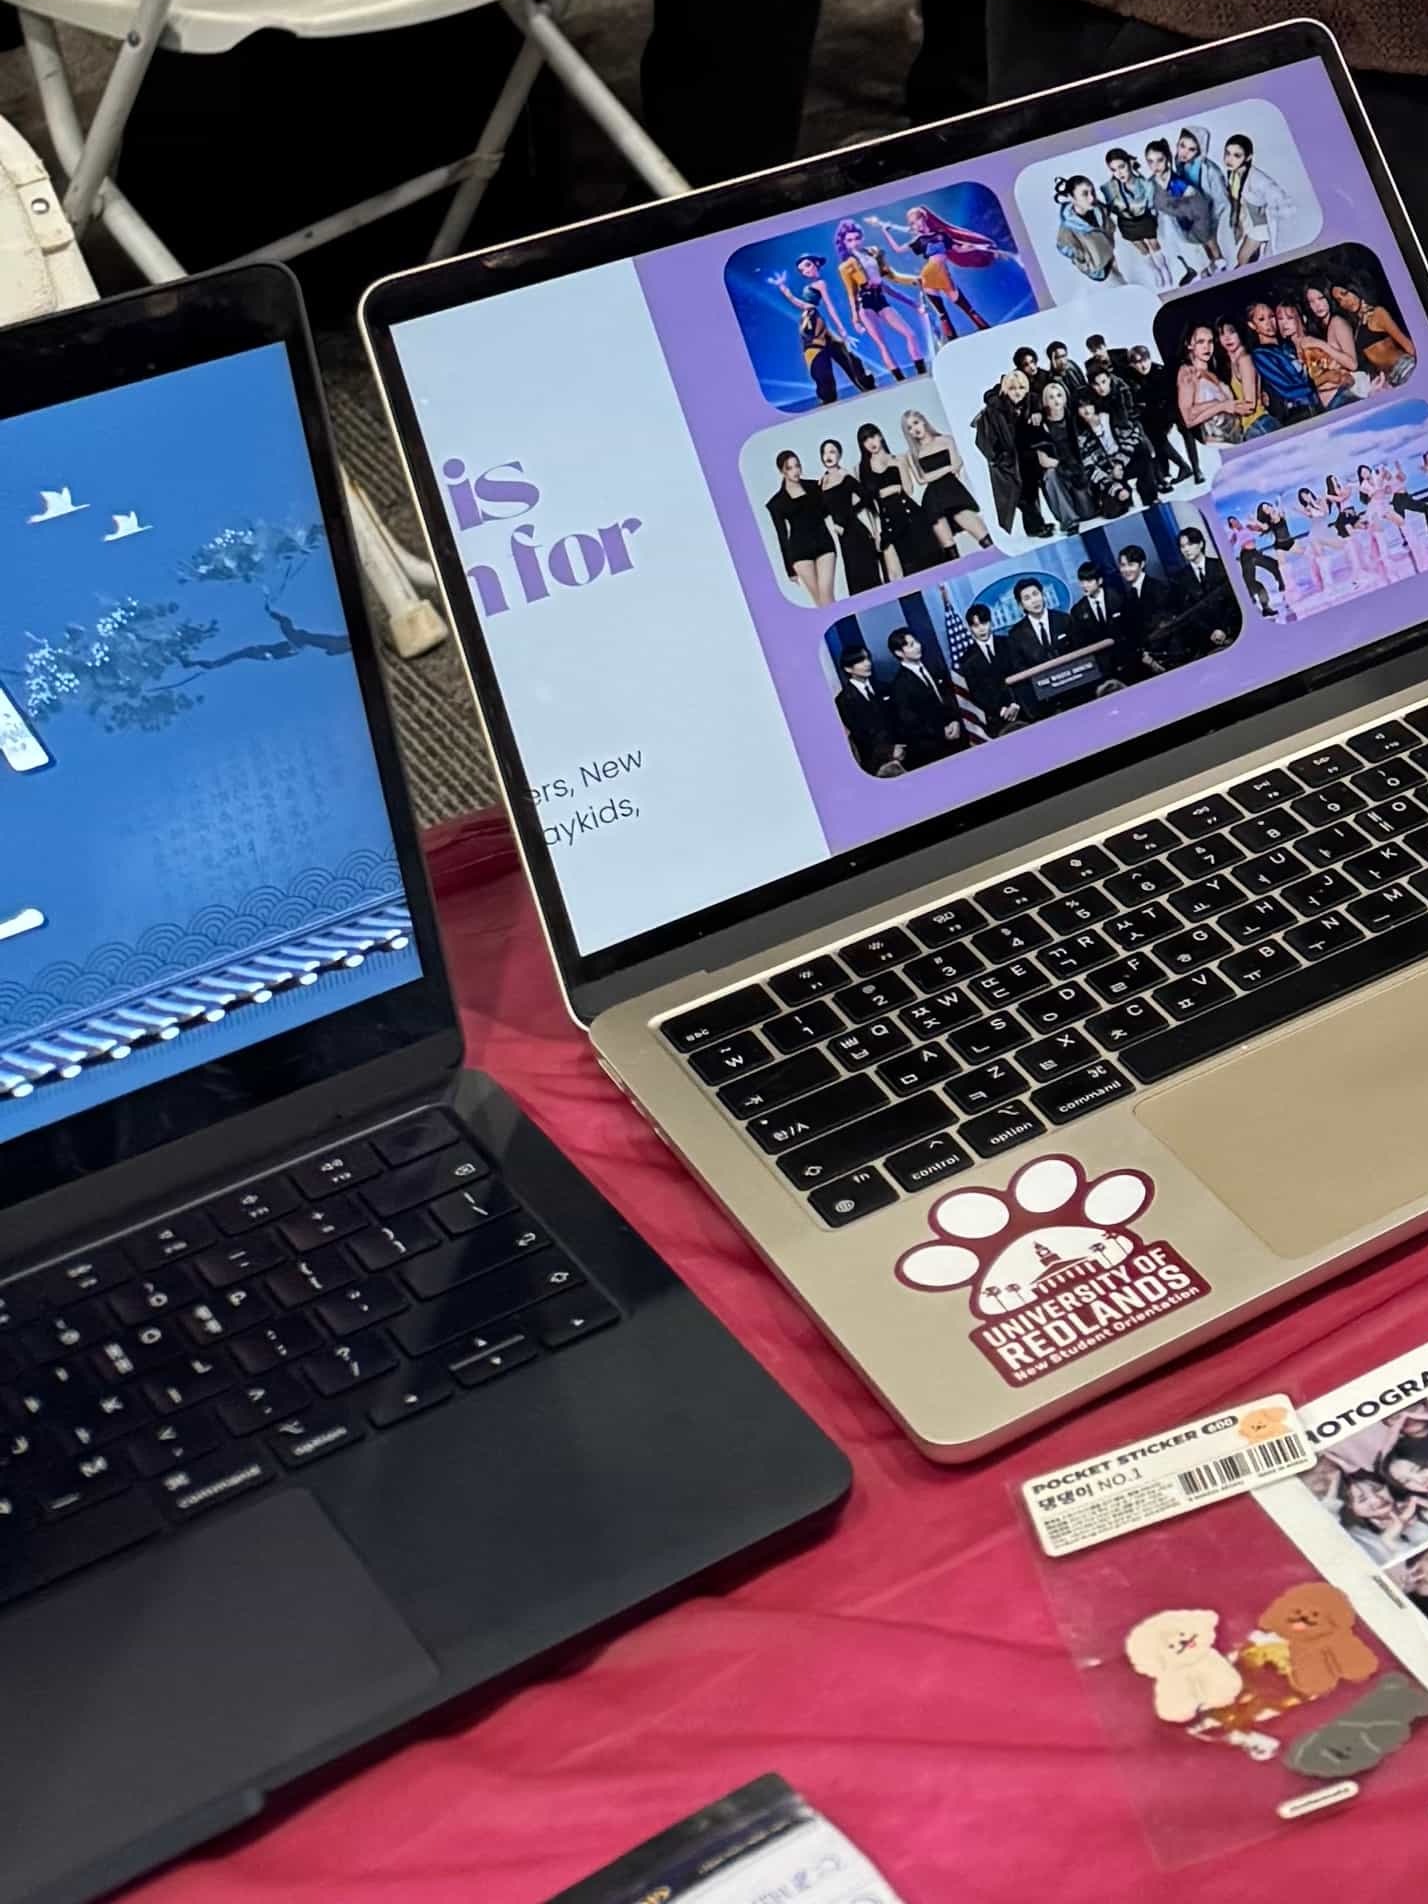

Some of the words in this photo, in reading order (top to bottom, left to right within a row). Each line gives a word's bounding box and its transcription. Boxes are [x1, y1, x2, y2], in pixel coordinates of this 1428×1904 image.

[442, 458, 540, 531] is
[509, 517, 643, 604] for
[578, 749, 643, 788] New
[685, 1028, 711, 1043] esc
[1058, 1079, 1122, 1114] command
[989, 1121, 1034, 1147] option
[911, 1153, 961, 1182] control
[981, 1264, 1128, 1350] UNIVERSITY
[1132, 1247, 1169, 1276] OF
[995, 1263, 1193, 1371] REDLANDS
[1013, 1358, 1050, 1382] New
[1049, 1327, 1114, 1365] Student
[1113, 1285, 1201, 1334] Orientation
[1031, 1460, 1112, 1495] POCKET
[1117, 1428, 1200, 1467] STICKER
[1036, 1484, 1095, 1512] 댕댕이
[1096, 1466, 1144, 1495] NO.1
